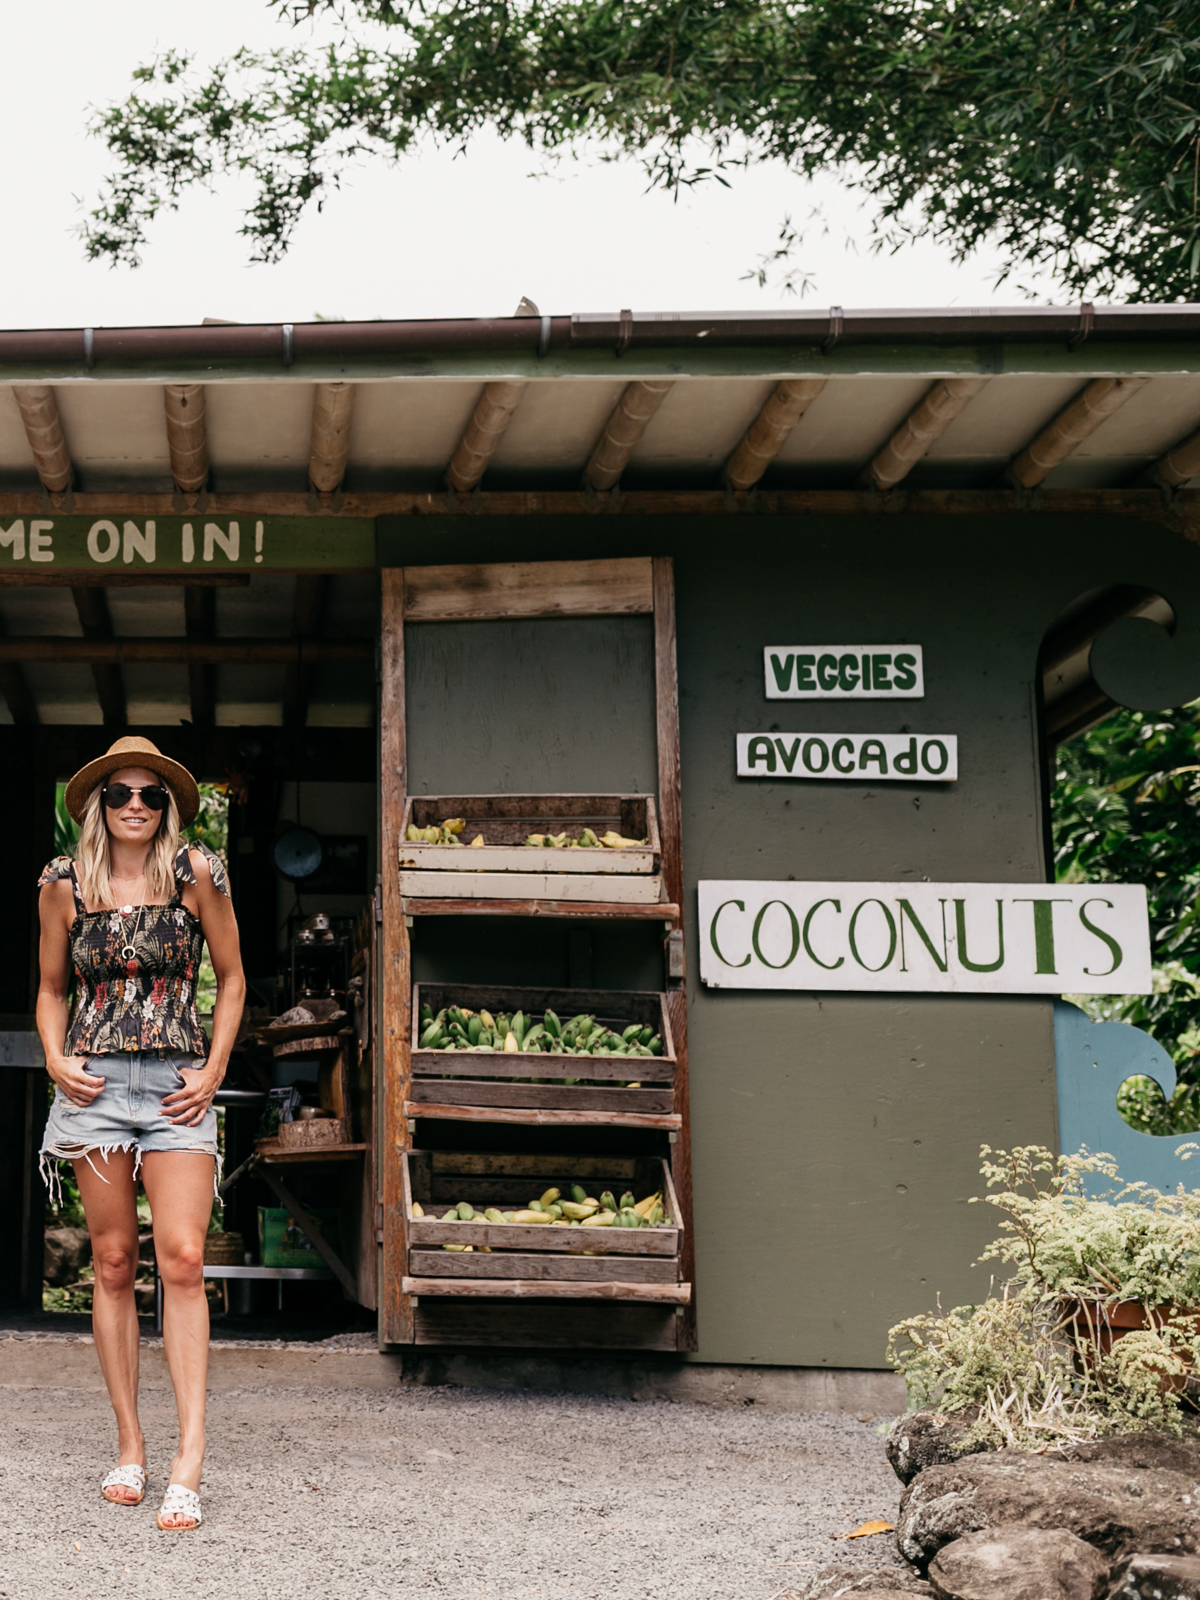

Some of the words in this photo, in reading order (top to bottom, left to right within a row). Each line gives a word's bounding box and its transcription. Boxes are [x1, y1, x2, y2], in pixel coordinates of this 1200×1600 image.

[87, 520, 156, 563] ON
[182, 520, 264, 563] IN!
[770, 653, 917, 691] VEGGIES
[710, 898, 1123, 976] COCONUTS
